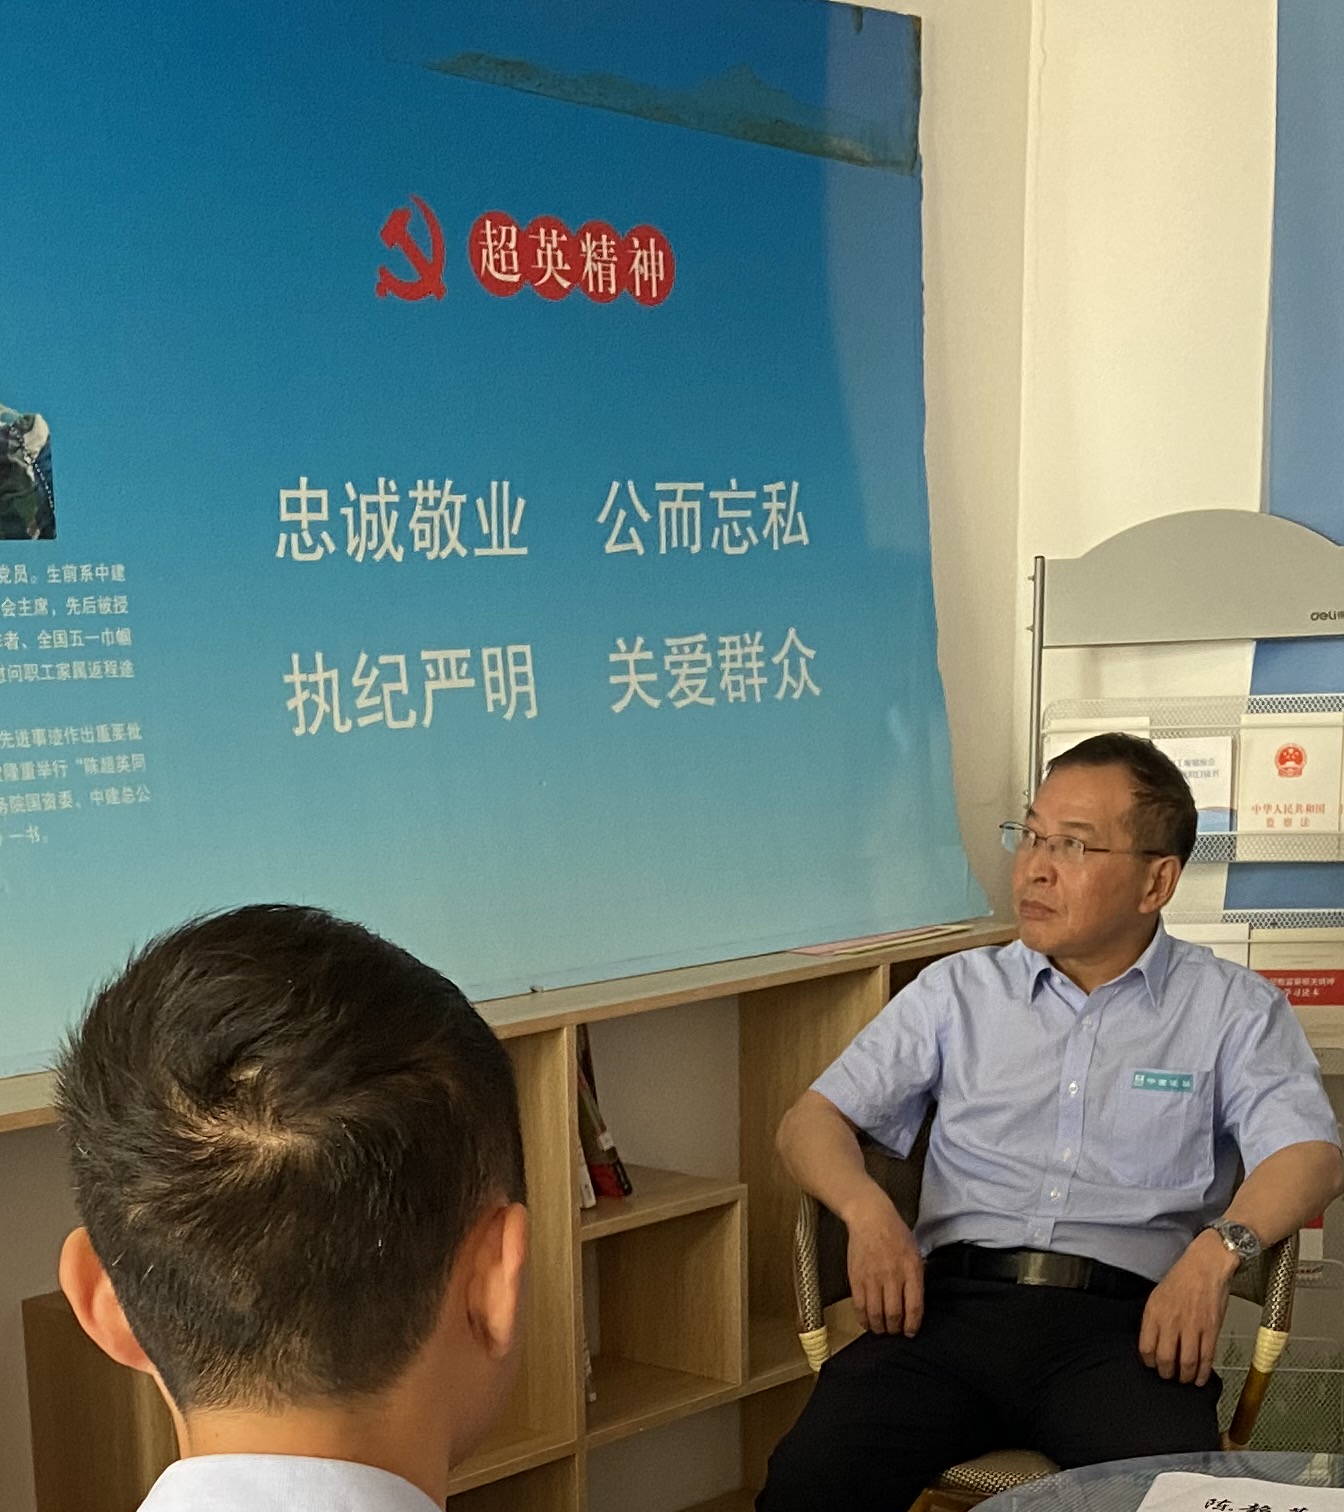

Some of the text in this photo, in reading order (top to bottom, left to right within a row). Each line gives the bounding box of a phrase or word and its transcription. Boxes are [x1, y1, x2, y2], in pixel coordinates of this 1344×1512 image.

[478, 219, 667, 299] 超英精神
[275, 476, 811, 563] 忠诚敬业 公而忘私
[283, 627, 823, 737] 执纪严明 关爱群众
